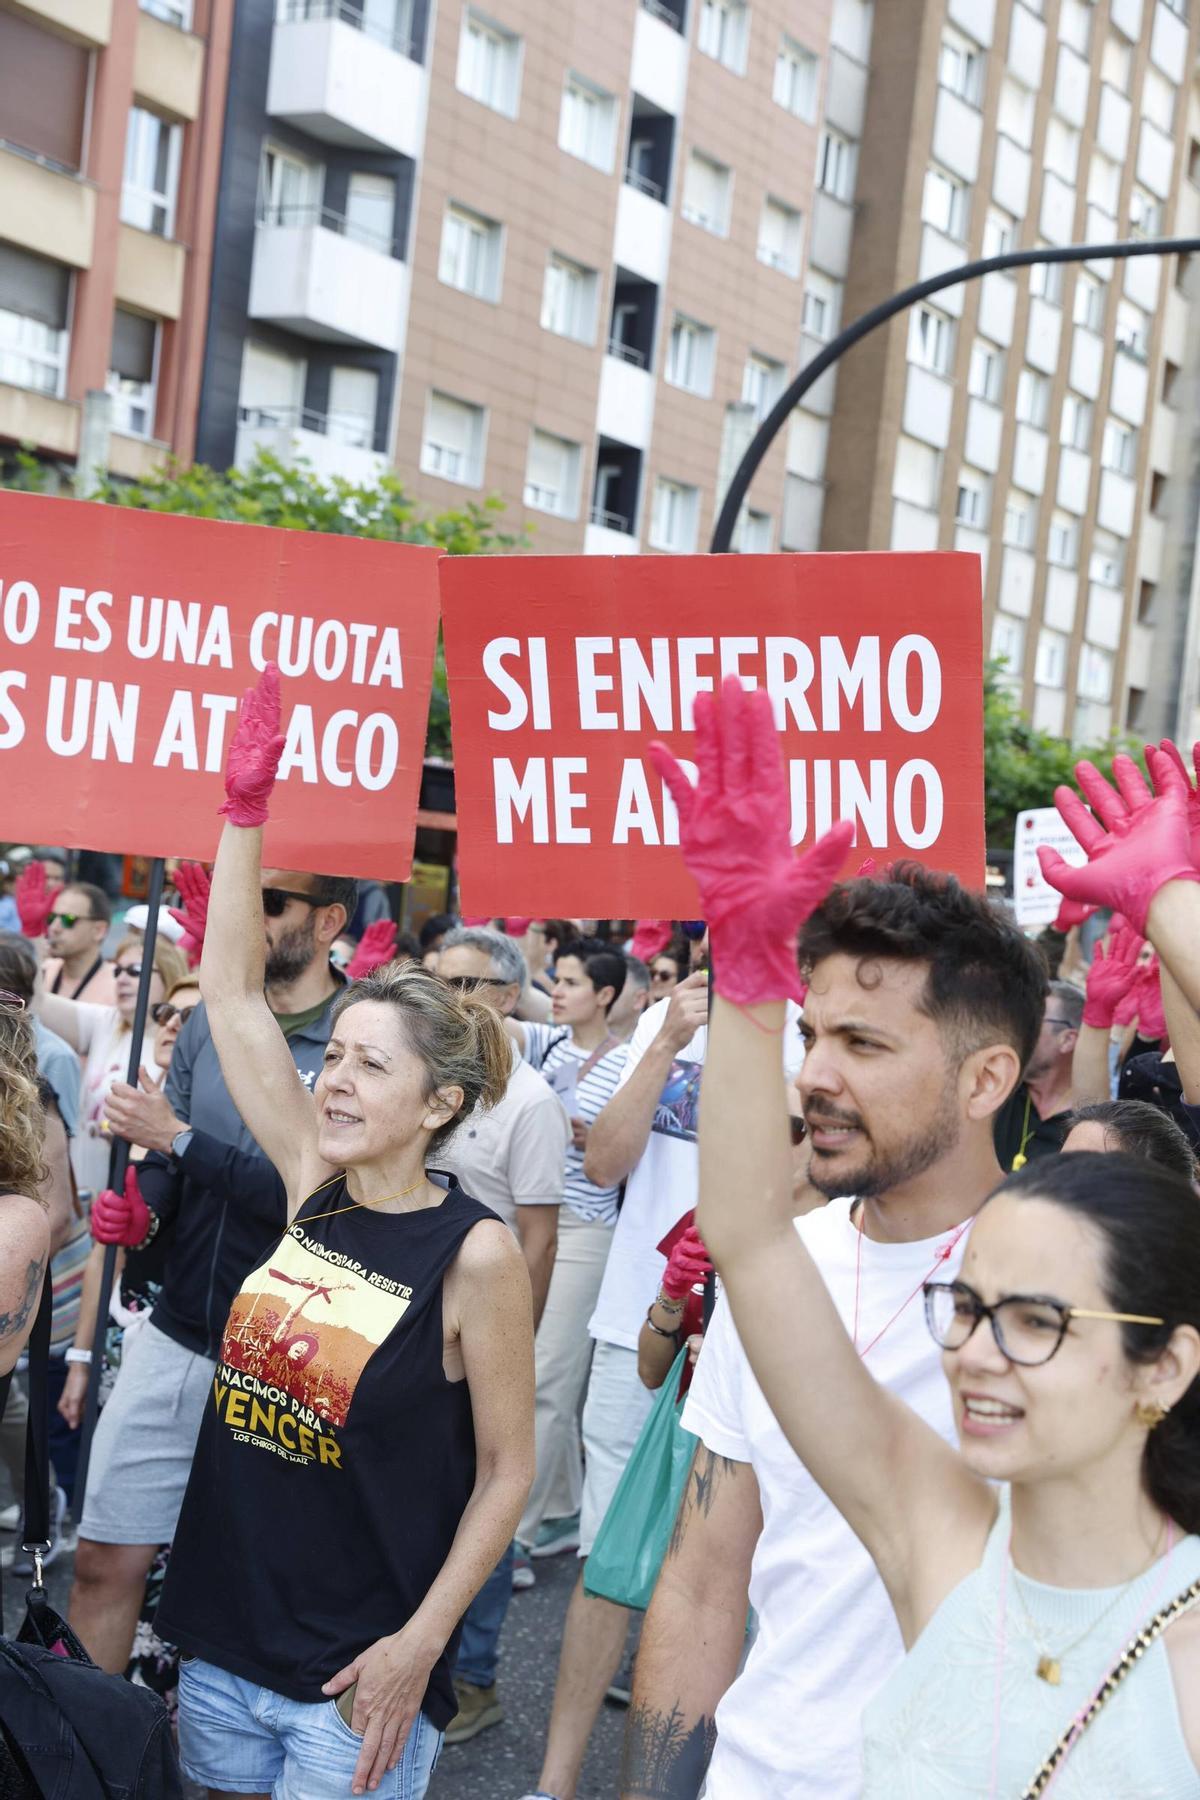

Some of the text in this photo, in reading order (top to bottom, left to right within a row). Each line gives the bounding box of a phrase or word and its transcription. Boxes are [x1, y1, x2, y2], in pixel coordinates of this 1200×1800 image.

[0, 579, 404, 689] O ES UNA CUOTA
[482, 634, 943, 733] SI ENFERMO
[45, 675, 140, 764] UN
[152, 689, 399, 791] ATACO
[493, 757, 945, 850] ME AINO
[286, 1224, 305, 1239] NO
[367, 1271, 413, 1300] RESISTIR
[214, 1377, 343, 1470] VENCER
[221, 1366, 323, 1433] NACIMOS PARA
[233, 1432, 250, 1443] LOS
[251, 1437, 277, 1453] CHIKOS
[277, 1447, 289, 1460] DEL
